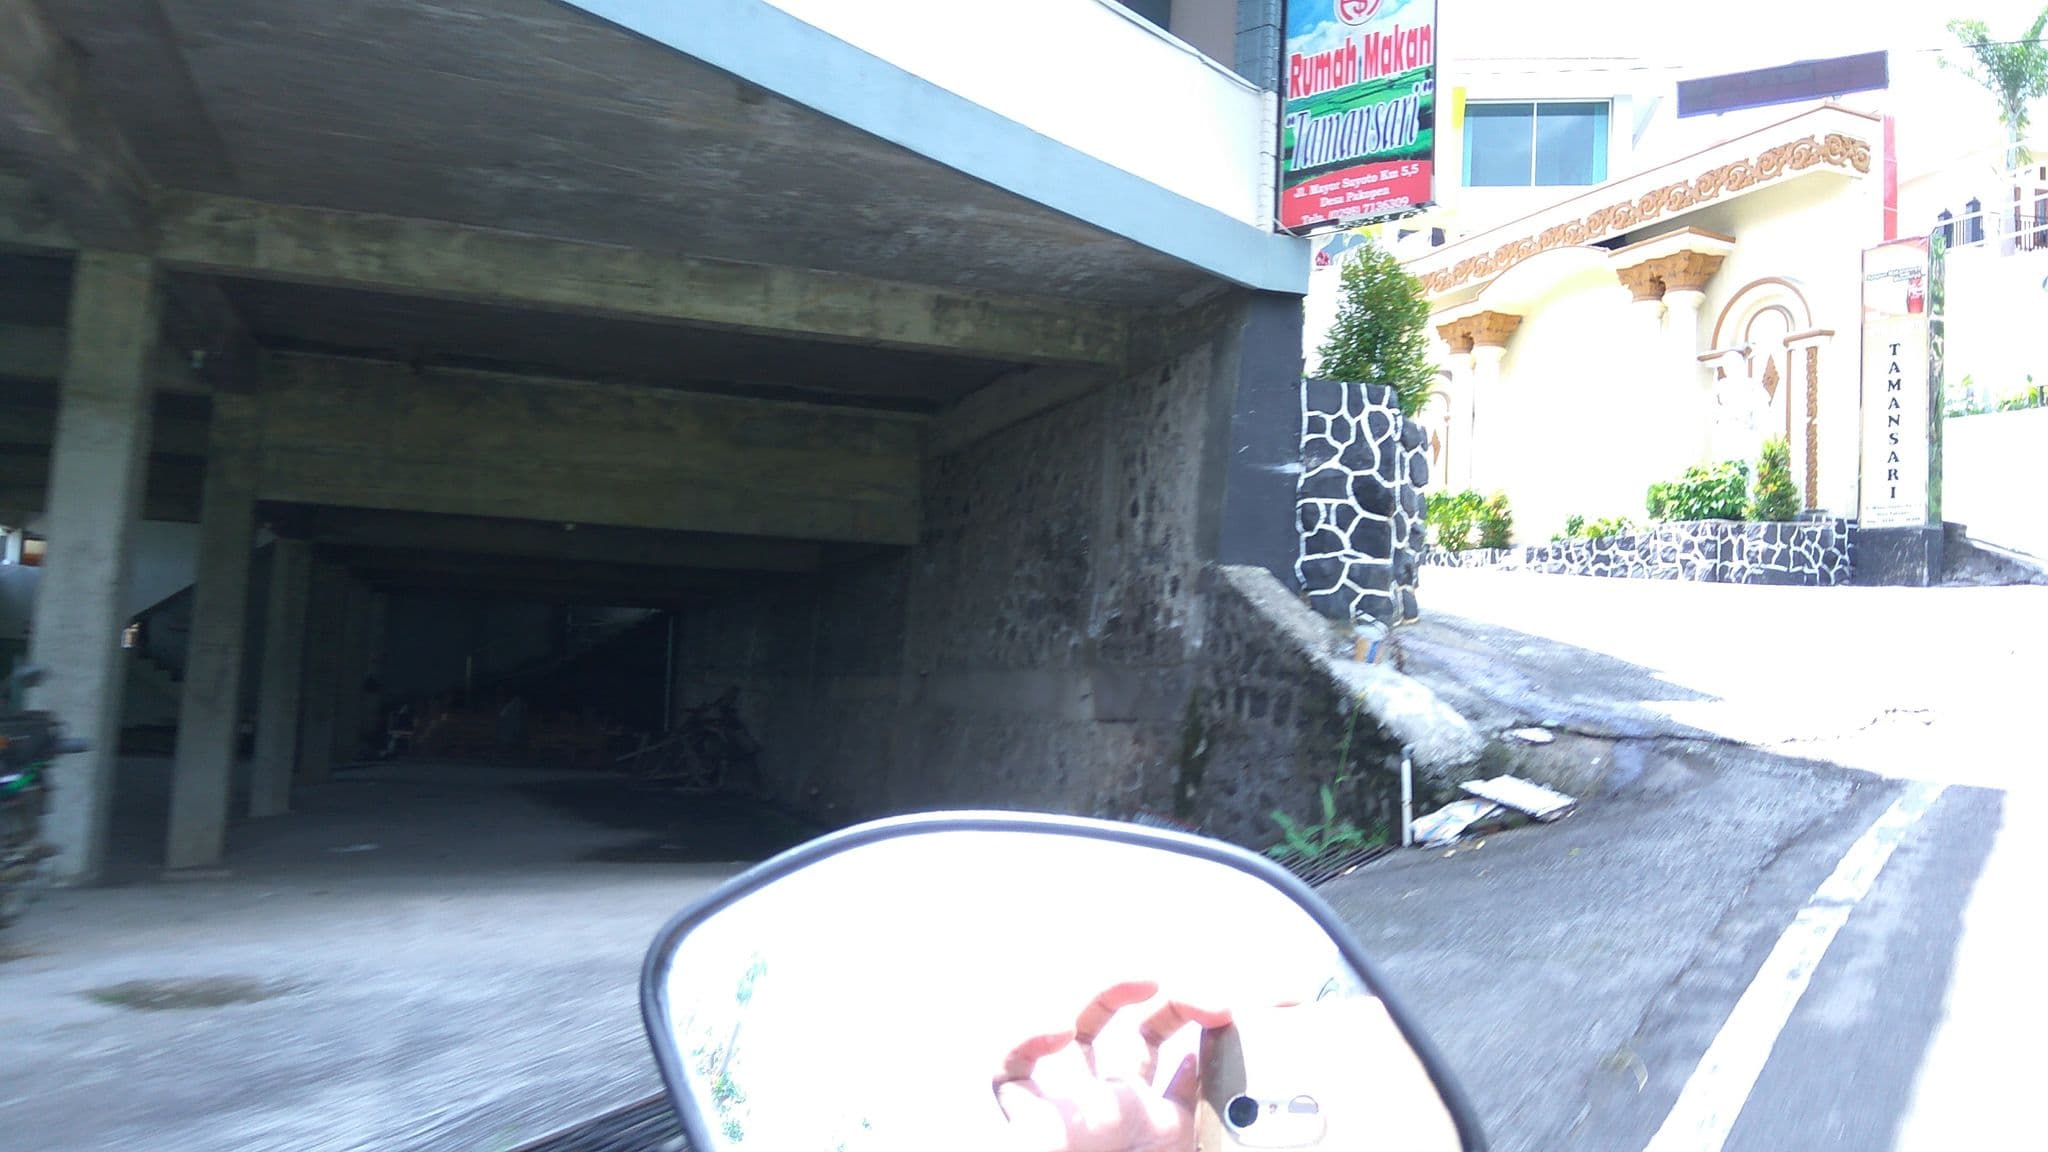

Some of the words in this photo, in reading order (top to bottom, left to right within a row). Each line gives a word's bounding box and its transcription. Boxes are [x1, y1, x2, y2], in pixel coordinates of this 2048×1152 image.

[1290, 37, 1357, 99] Rumah
[1363, 24, 1432, 80] Makan
[1380, 169, 1399, 181] Km
[1400, 163, 1420, 177] 5,5
[1319, 195, 1345, 207] Desa
[1888, 343, 1901, 499] TAMANSARI
